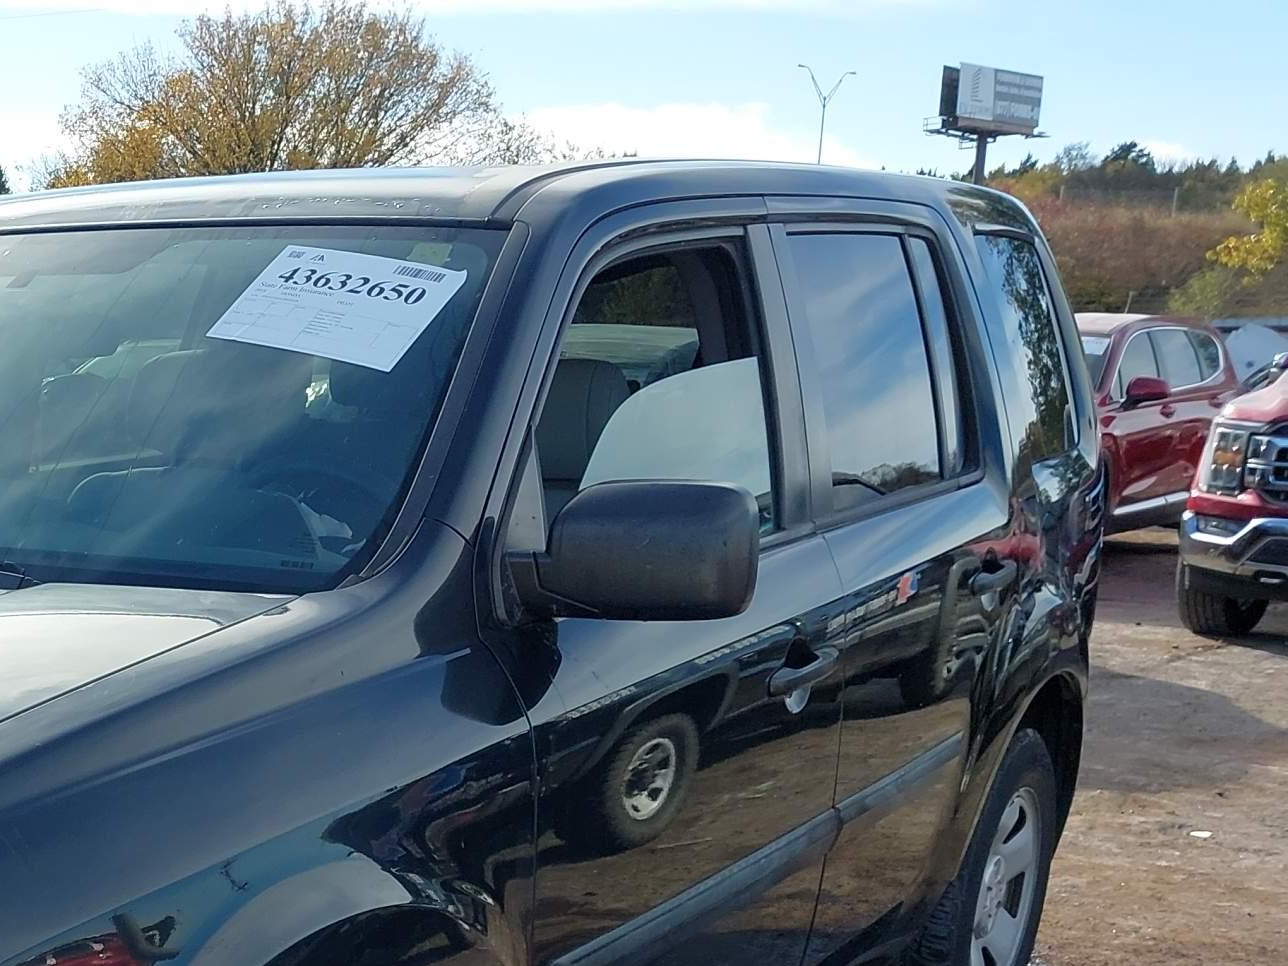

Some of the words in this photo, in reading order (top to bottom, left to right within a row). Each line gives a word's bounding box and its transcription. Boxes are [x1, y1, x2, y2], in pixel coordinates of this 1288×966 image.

[260, 281, 278, 290] State
[278, 283, 298, 292] Farm
[298, 286, 335, 297] Insurance
[278, 267, 427, 305] 43632650
